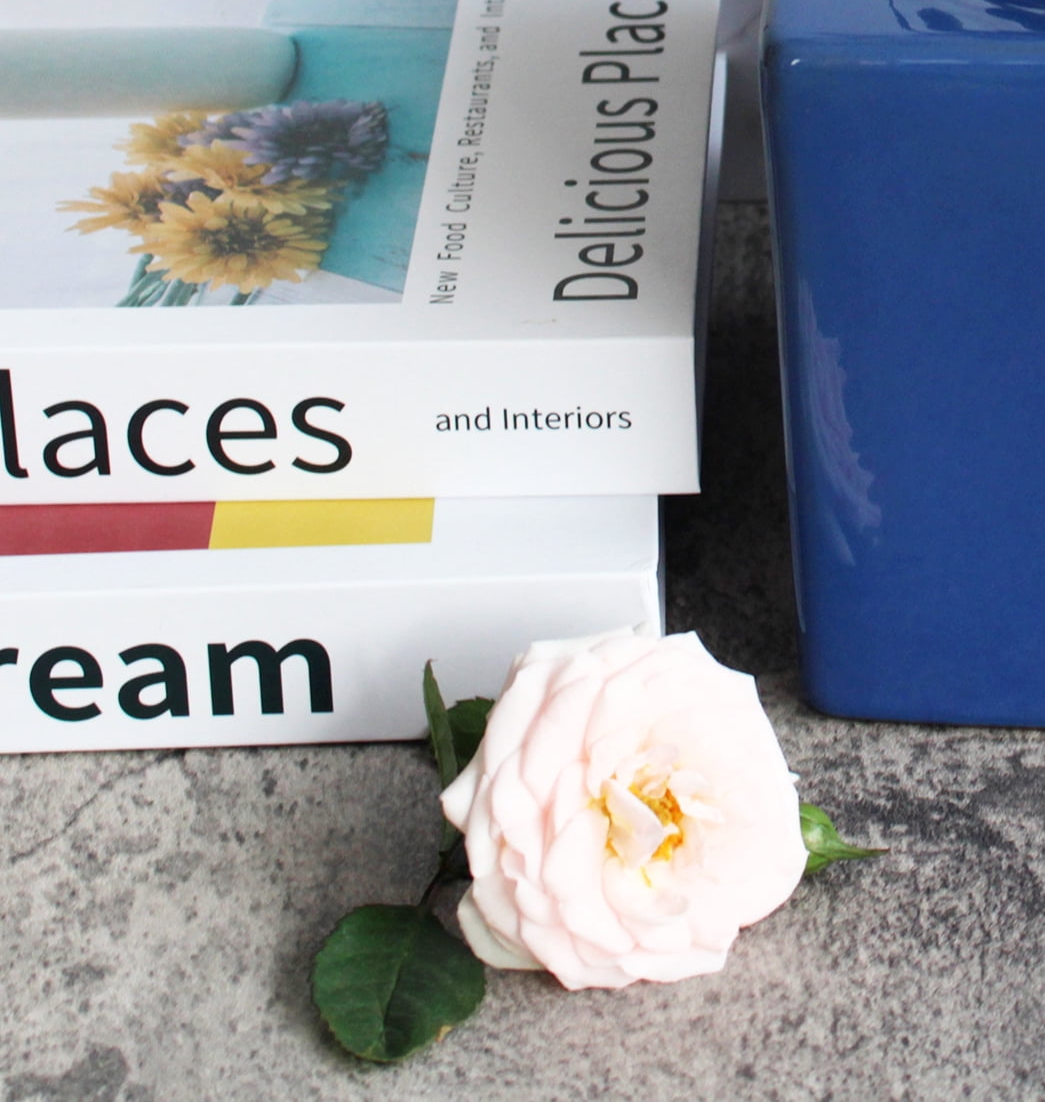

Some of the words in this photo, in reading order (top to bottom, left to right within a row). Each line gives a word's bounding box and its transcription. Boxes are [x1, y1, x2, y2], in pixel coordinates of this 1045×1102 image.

[477, 26, 500, 51] and
[458, 54, 496, 146] Restaurants,
[446, 151, 484, 213] Culture,
[552, 97, 659, 301] Delicious
[437, 223, 467, 260] Food
[429, 271, 458, 304] New
[435, 407, 492, 432] and
[502, 406, 632, 430] Interiors
